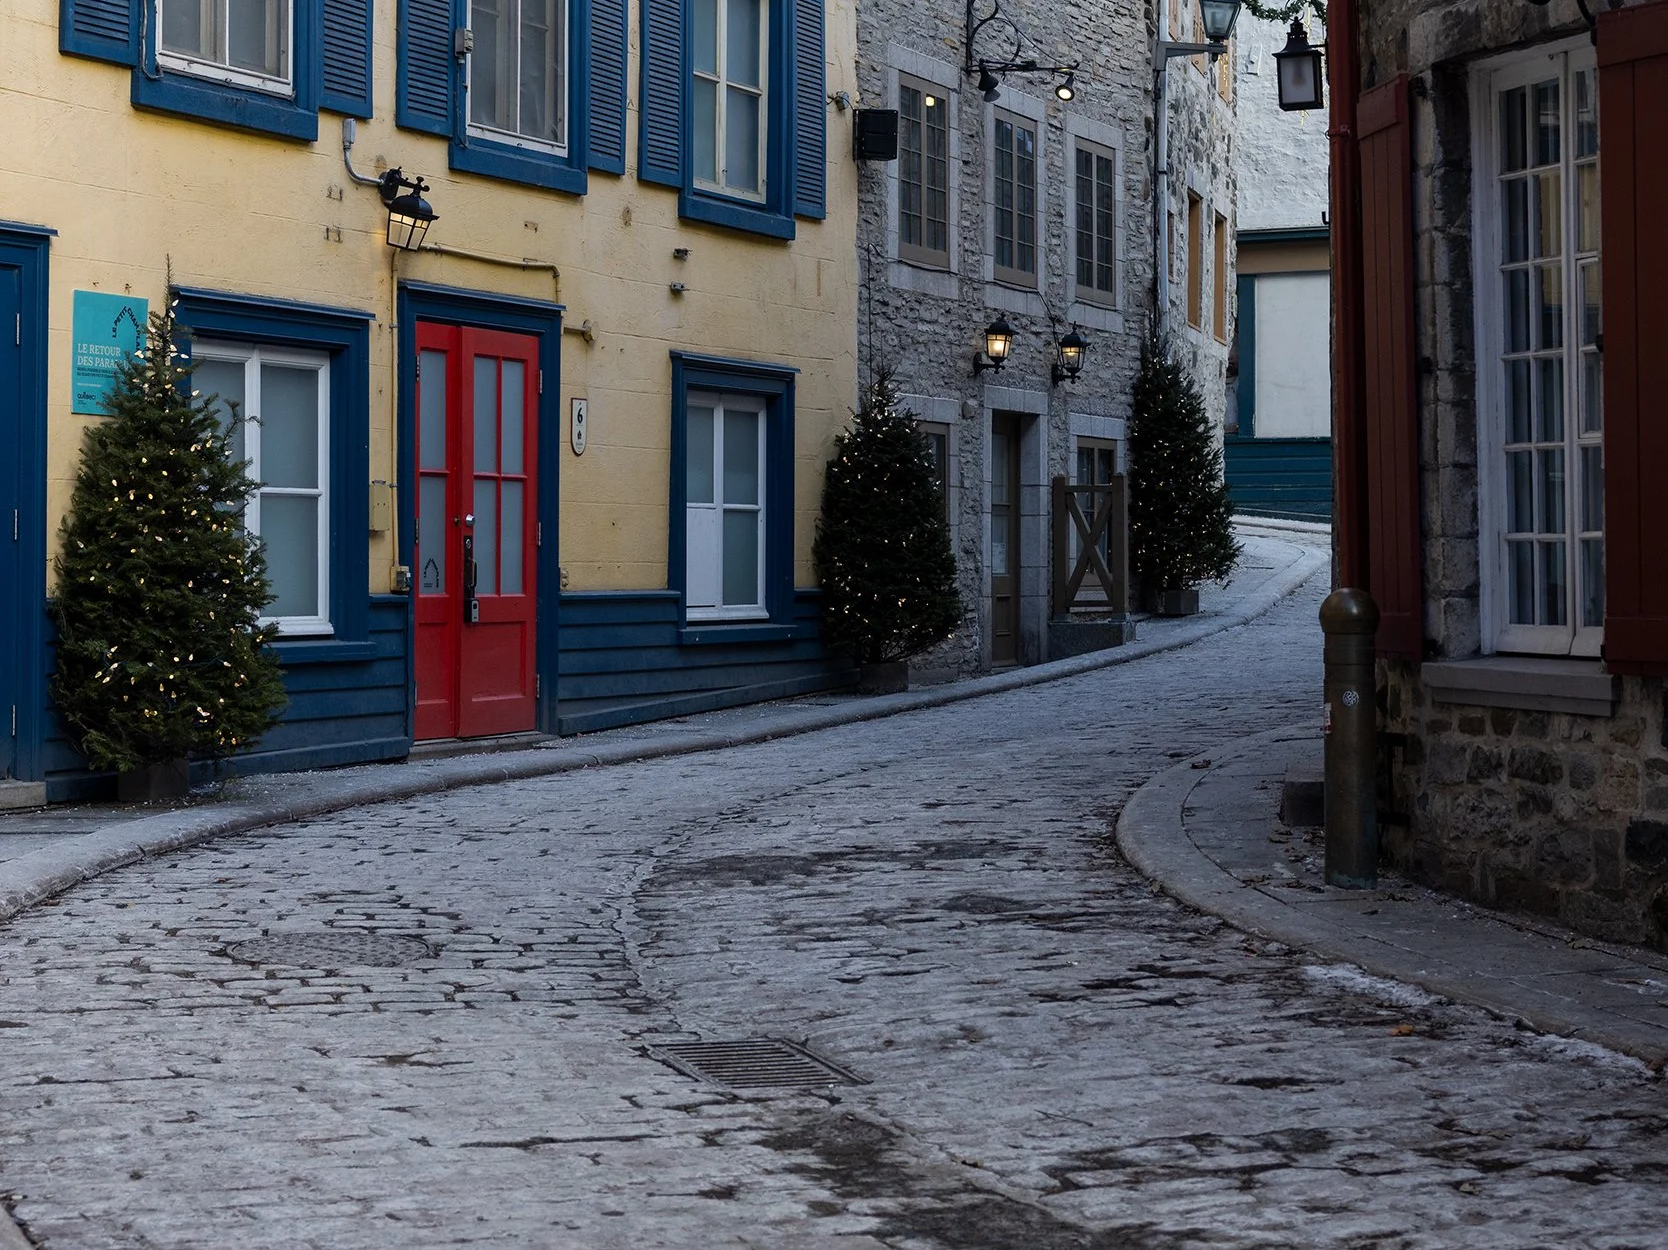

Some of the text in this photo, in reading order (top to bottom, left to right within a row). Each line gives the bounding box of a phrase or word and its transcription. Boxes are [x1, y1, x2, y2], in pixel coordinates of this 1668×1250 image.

[112, 306, 141, 351] LE PETIT CHAMPLAI
[77, 343, 121, 357] LE RETOUR
[77, 356, 94, 367] DES
[577, 407, 583, 424] 6
